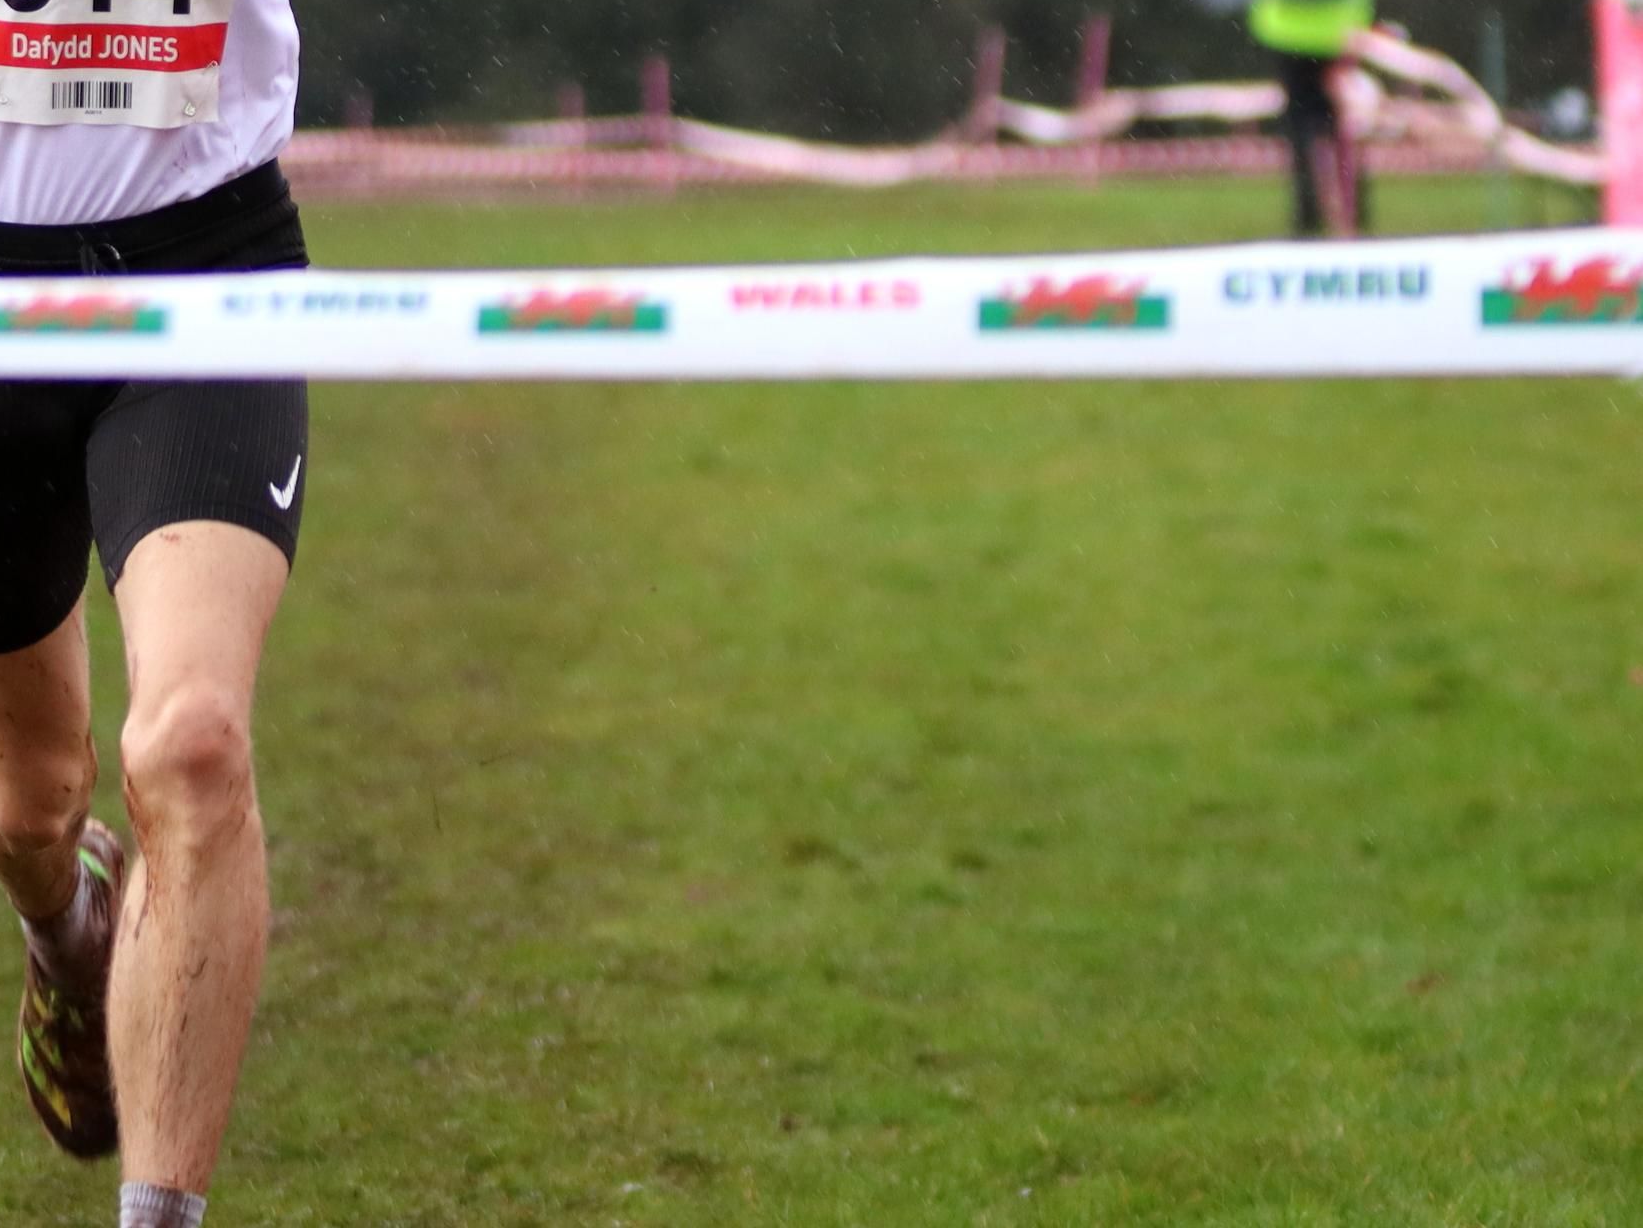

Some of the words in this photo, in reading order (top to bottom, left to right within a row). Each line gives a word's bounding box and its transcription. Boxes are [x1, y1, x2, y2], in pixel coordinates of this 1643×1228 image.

[11, 32, 93, 66] Dafydd
[98, 34, 179, 63] JONES
[1223, 266, 1432, 304] CYMRU
